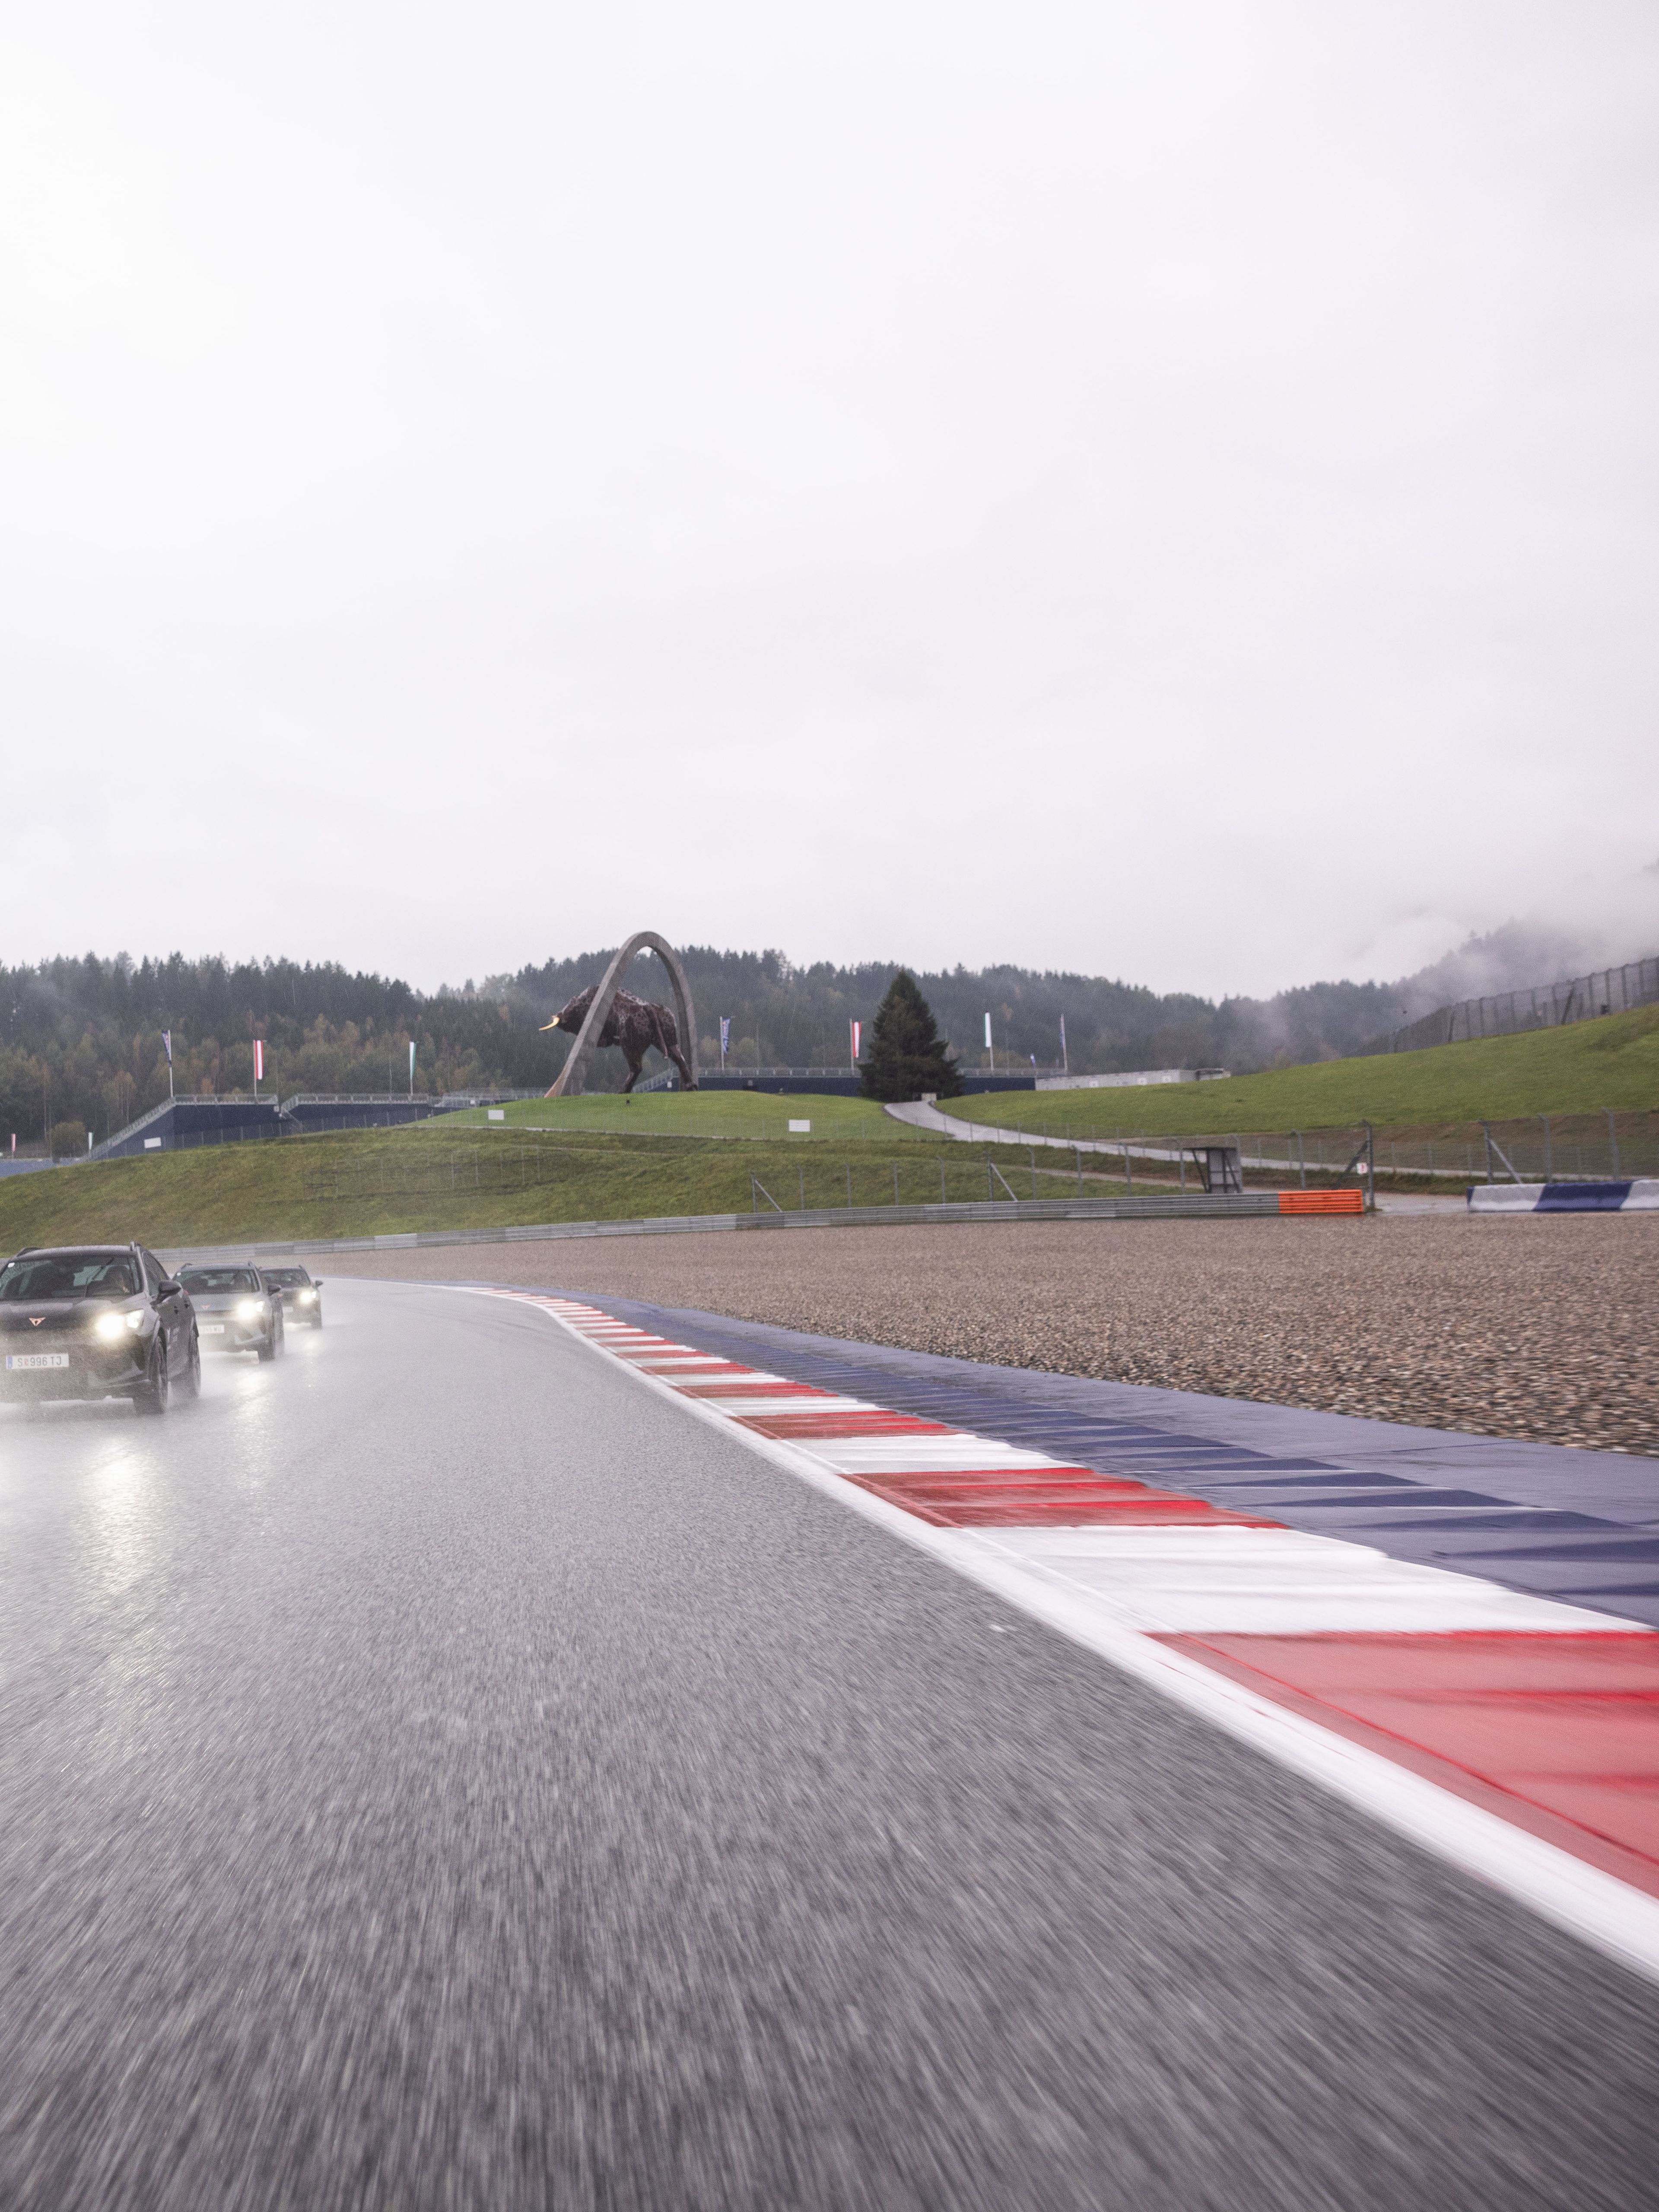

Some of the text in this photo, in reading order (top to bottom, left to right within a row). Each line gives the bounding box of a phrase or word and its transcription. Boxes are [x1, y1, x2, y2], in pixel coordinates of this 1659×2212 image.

[17, 1356, 61, 1367] S 996 TJ
